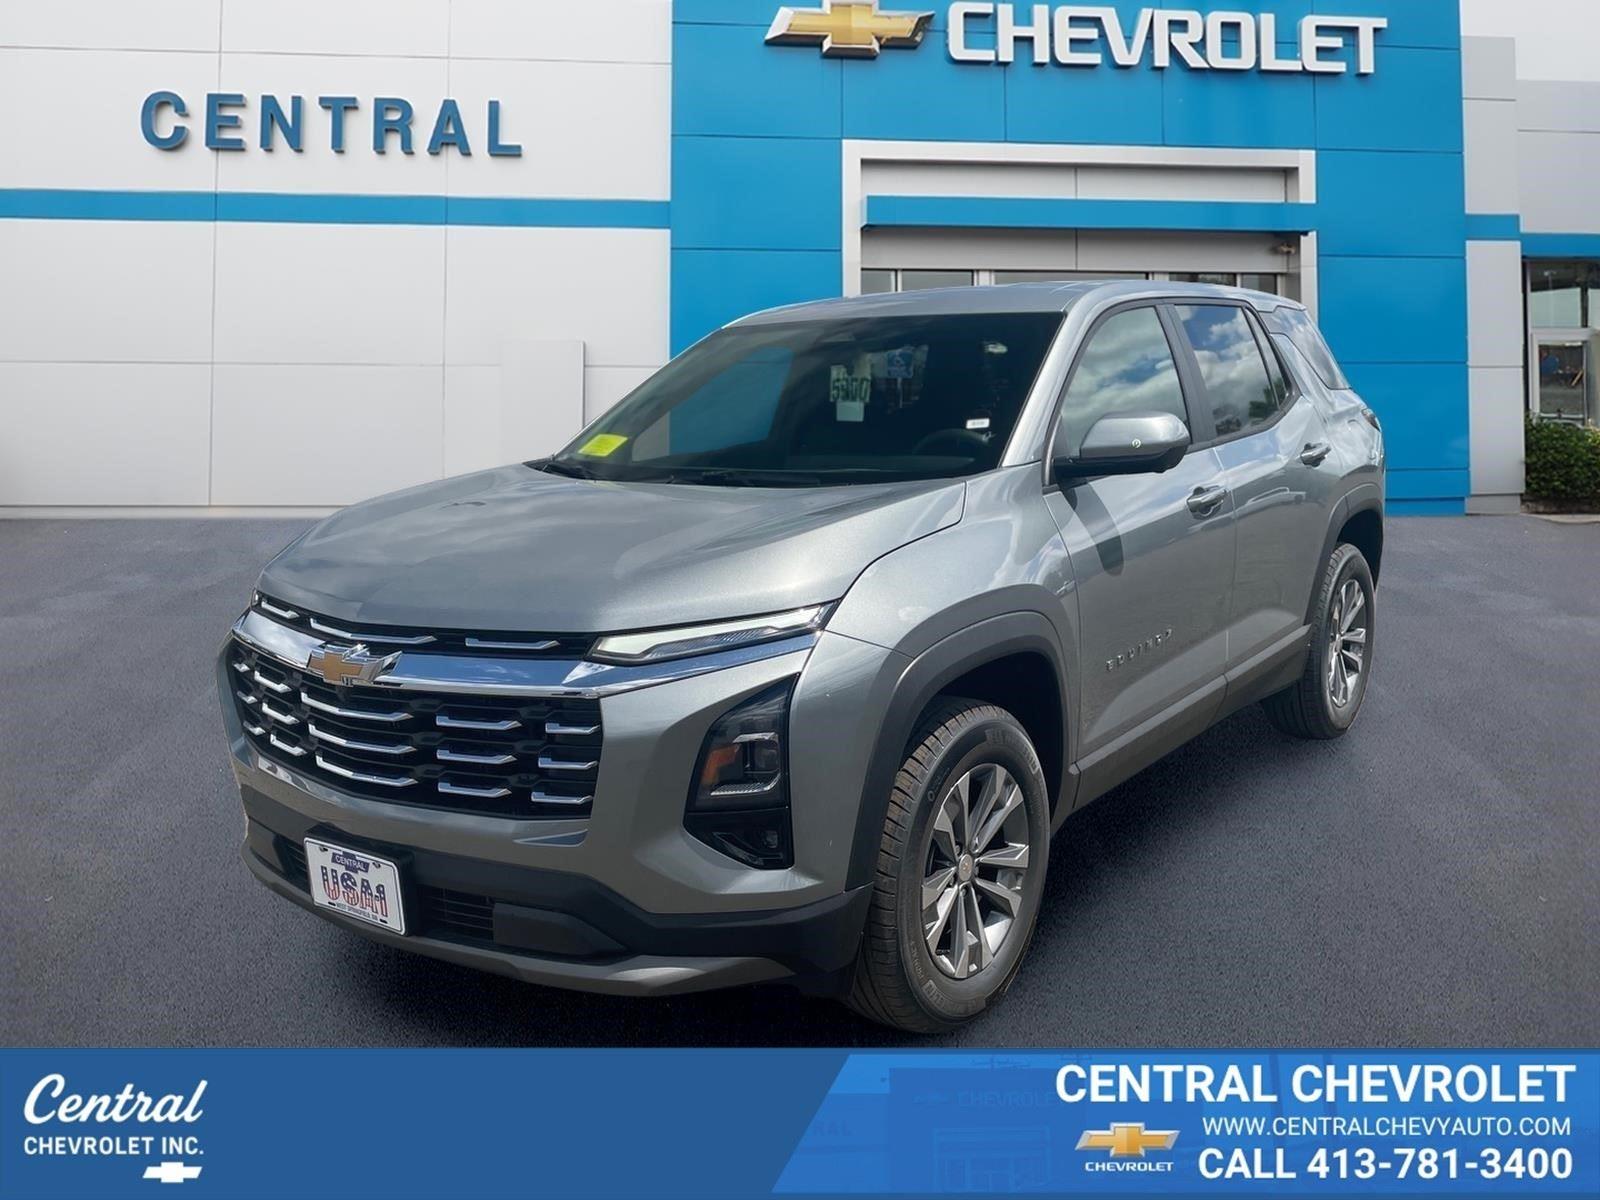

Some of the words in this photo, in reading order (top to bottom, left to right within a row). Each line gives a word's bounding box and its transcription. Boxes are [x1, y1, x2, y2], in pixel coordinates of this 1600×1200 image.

[947, 2, 1388, 75] CHEVROLET
[140, 90, 523, 157] CENTRAL
[334, 854, 368, 871] CENTRAL
